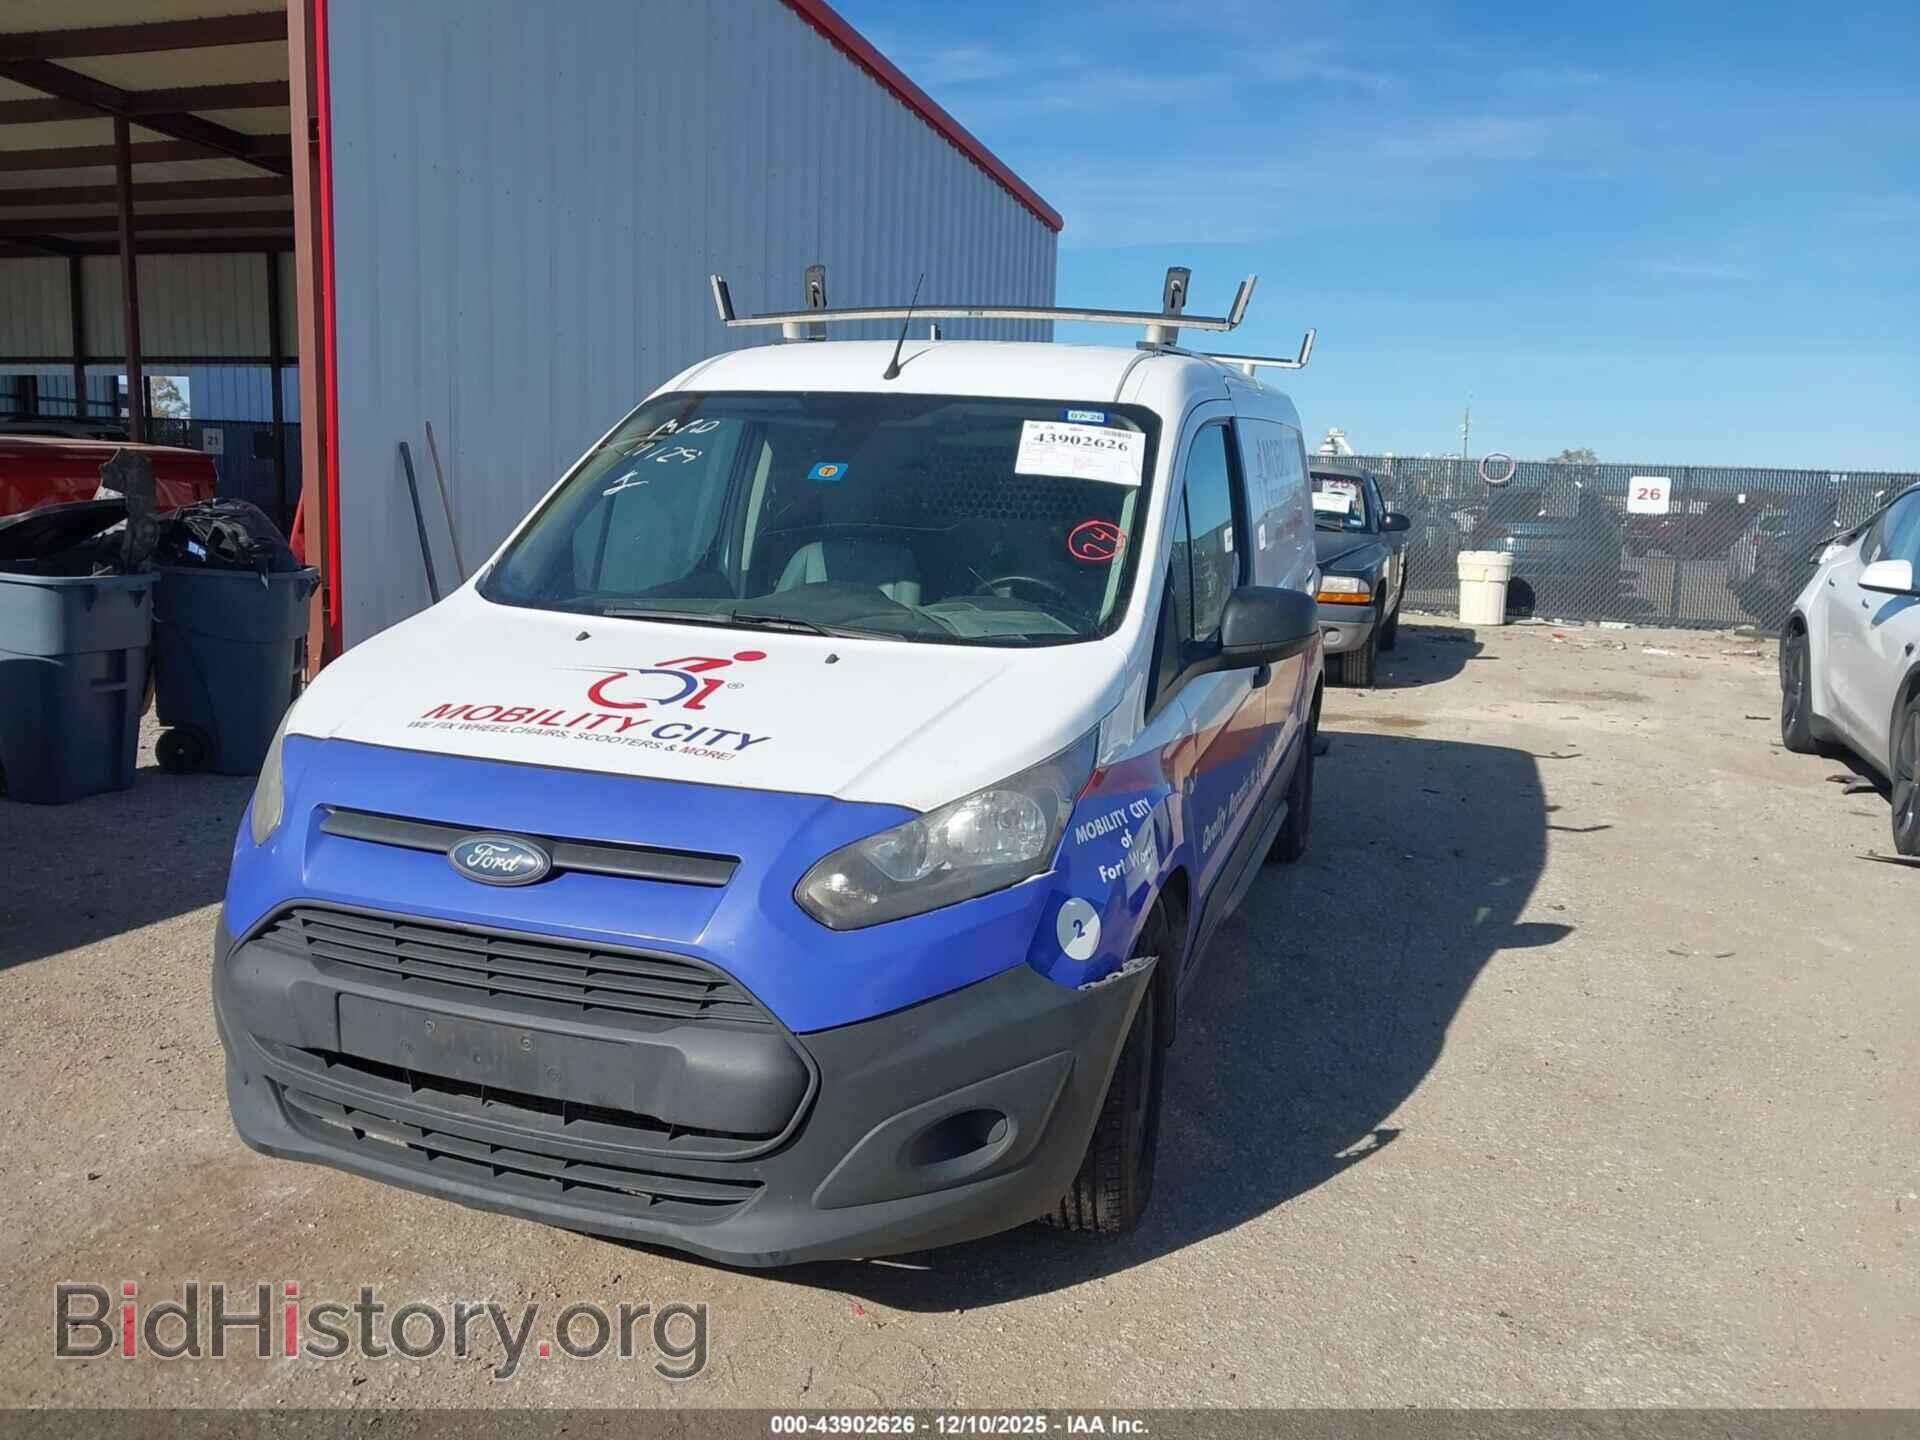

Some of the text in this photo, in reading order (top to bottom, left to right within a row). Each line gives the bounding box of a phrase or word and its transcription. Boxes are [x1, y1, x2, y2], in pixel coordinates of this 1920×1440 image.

[1033, 433, 1128, 452] 43902626
[1637, 487, 1662, 501] 26
[420, 703, 772, 751] MOBILITY CITY
[407, 721, 433, 729] WE
[432, 722, 455, 731] FIX
[573, 731, 663, 750] SCOOTERS
[679, 746, 737, 761] MORE!
[1075, 797, 1154, 846] MOBILITY CITY
[1120, 828, 1134, 849] of
[466, 843, 522, 873] Ford
[1098, 858, 1126, 884] Fort
[1072, 919, 1086, 938] 2
